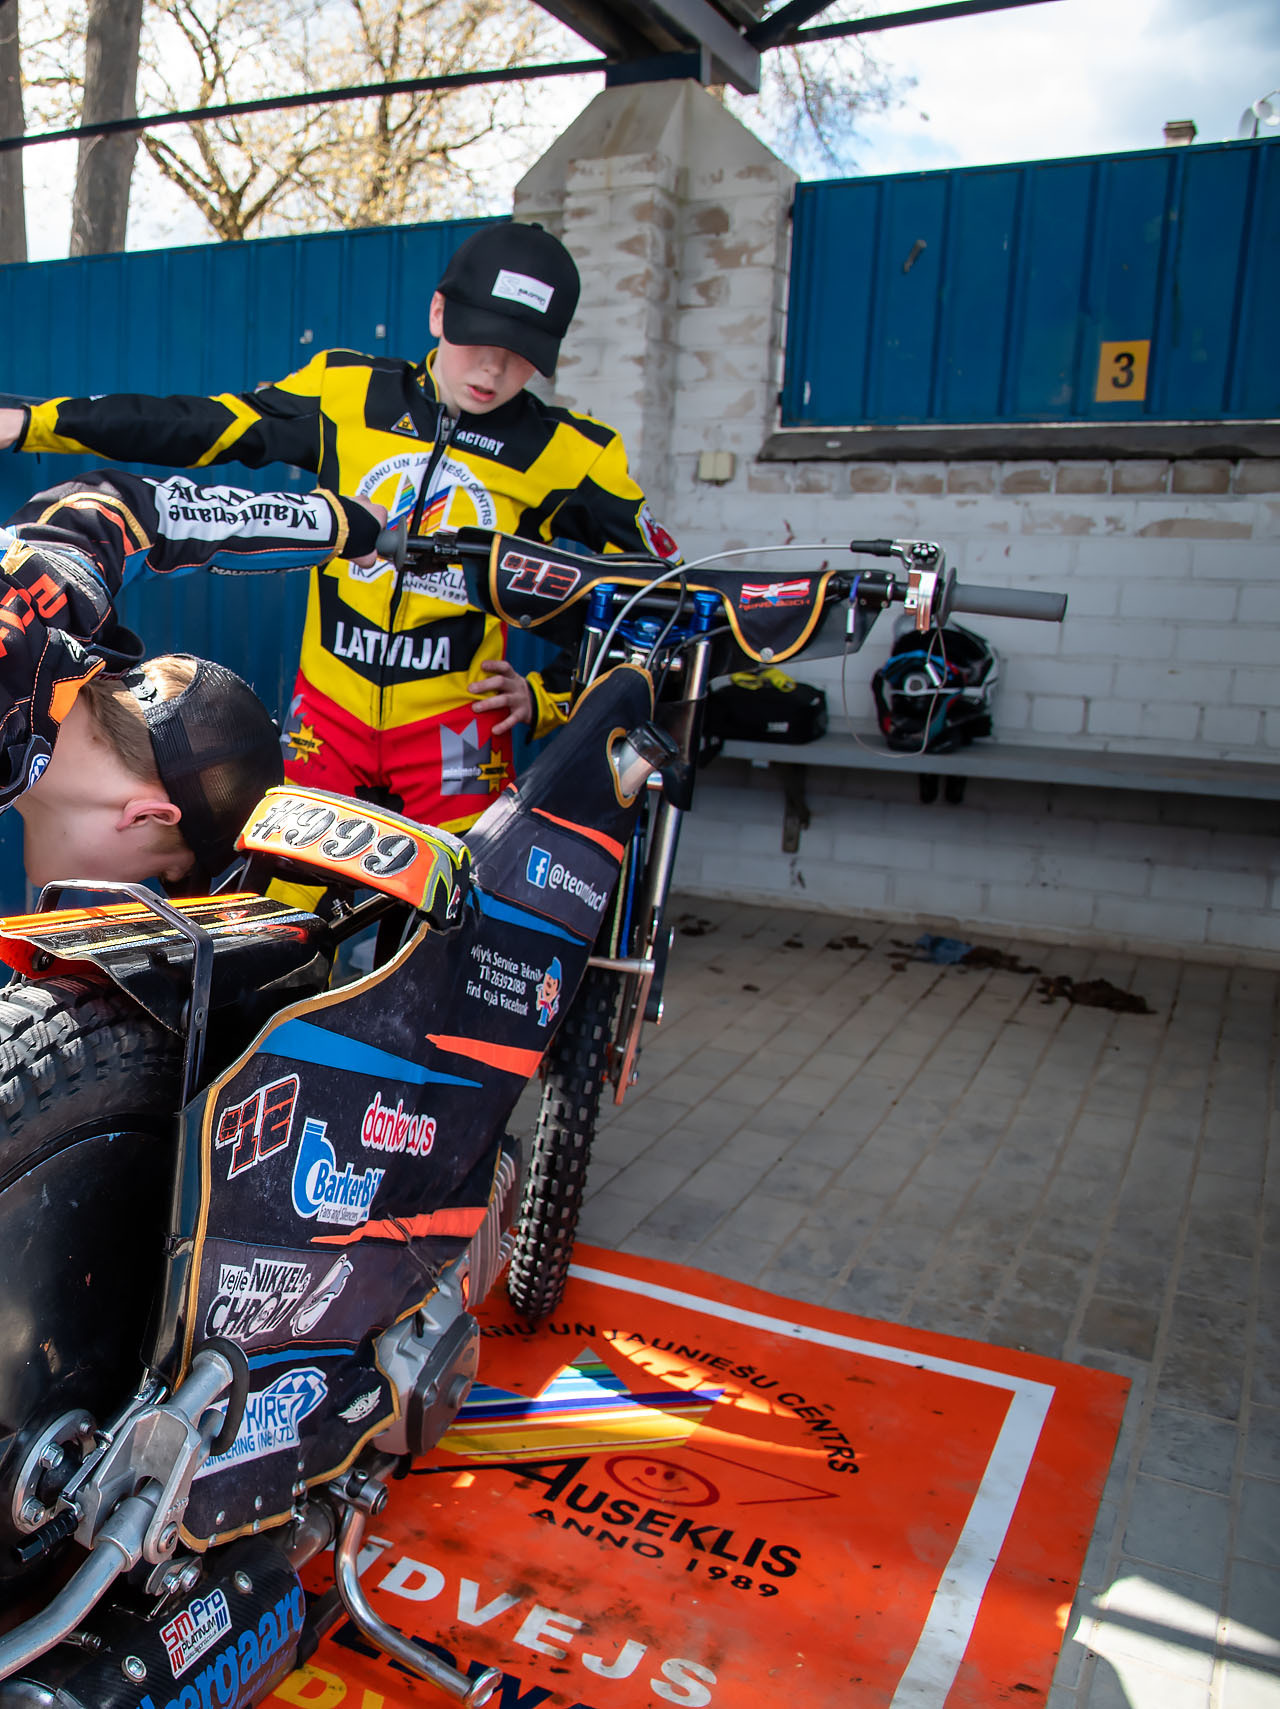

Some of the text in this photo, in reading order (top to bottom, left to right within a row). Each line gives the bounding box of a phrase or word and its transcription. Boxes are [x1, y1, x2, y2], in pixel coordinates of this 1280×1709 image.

[1111, 352, 1135, 389] 3
[456, 429, 505, 456] ACTORY
[333, 621, 451, 671] LATVIJA
[251, 799, 420, 878] #999
[220, 1268, 249, 1296] Vejle
[549, 1322, 596, 1338] UN
[502, 1455, 802, 1579] AUSEKLIS
[529, 1508, 780, 1598] ANNO 1989
[180, 1615, 217, 1655] PLATINUM
